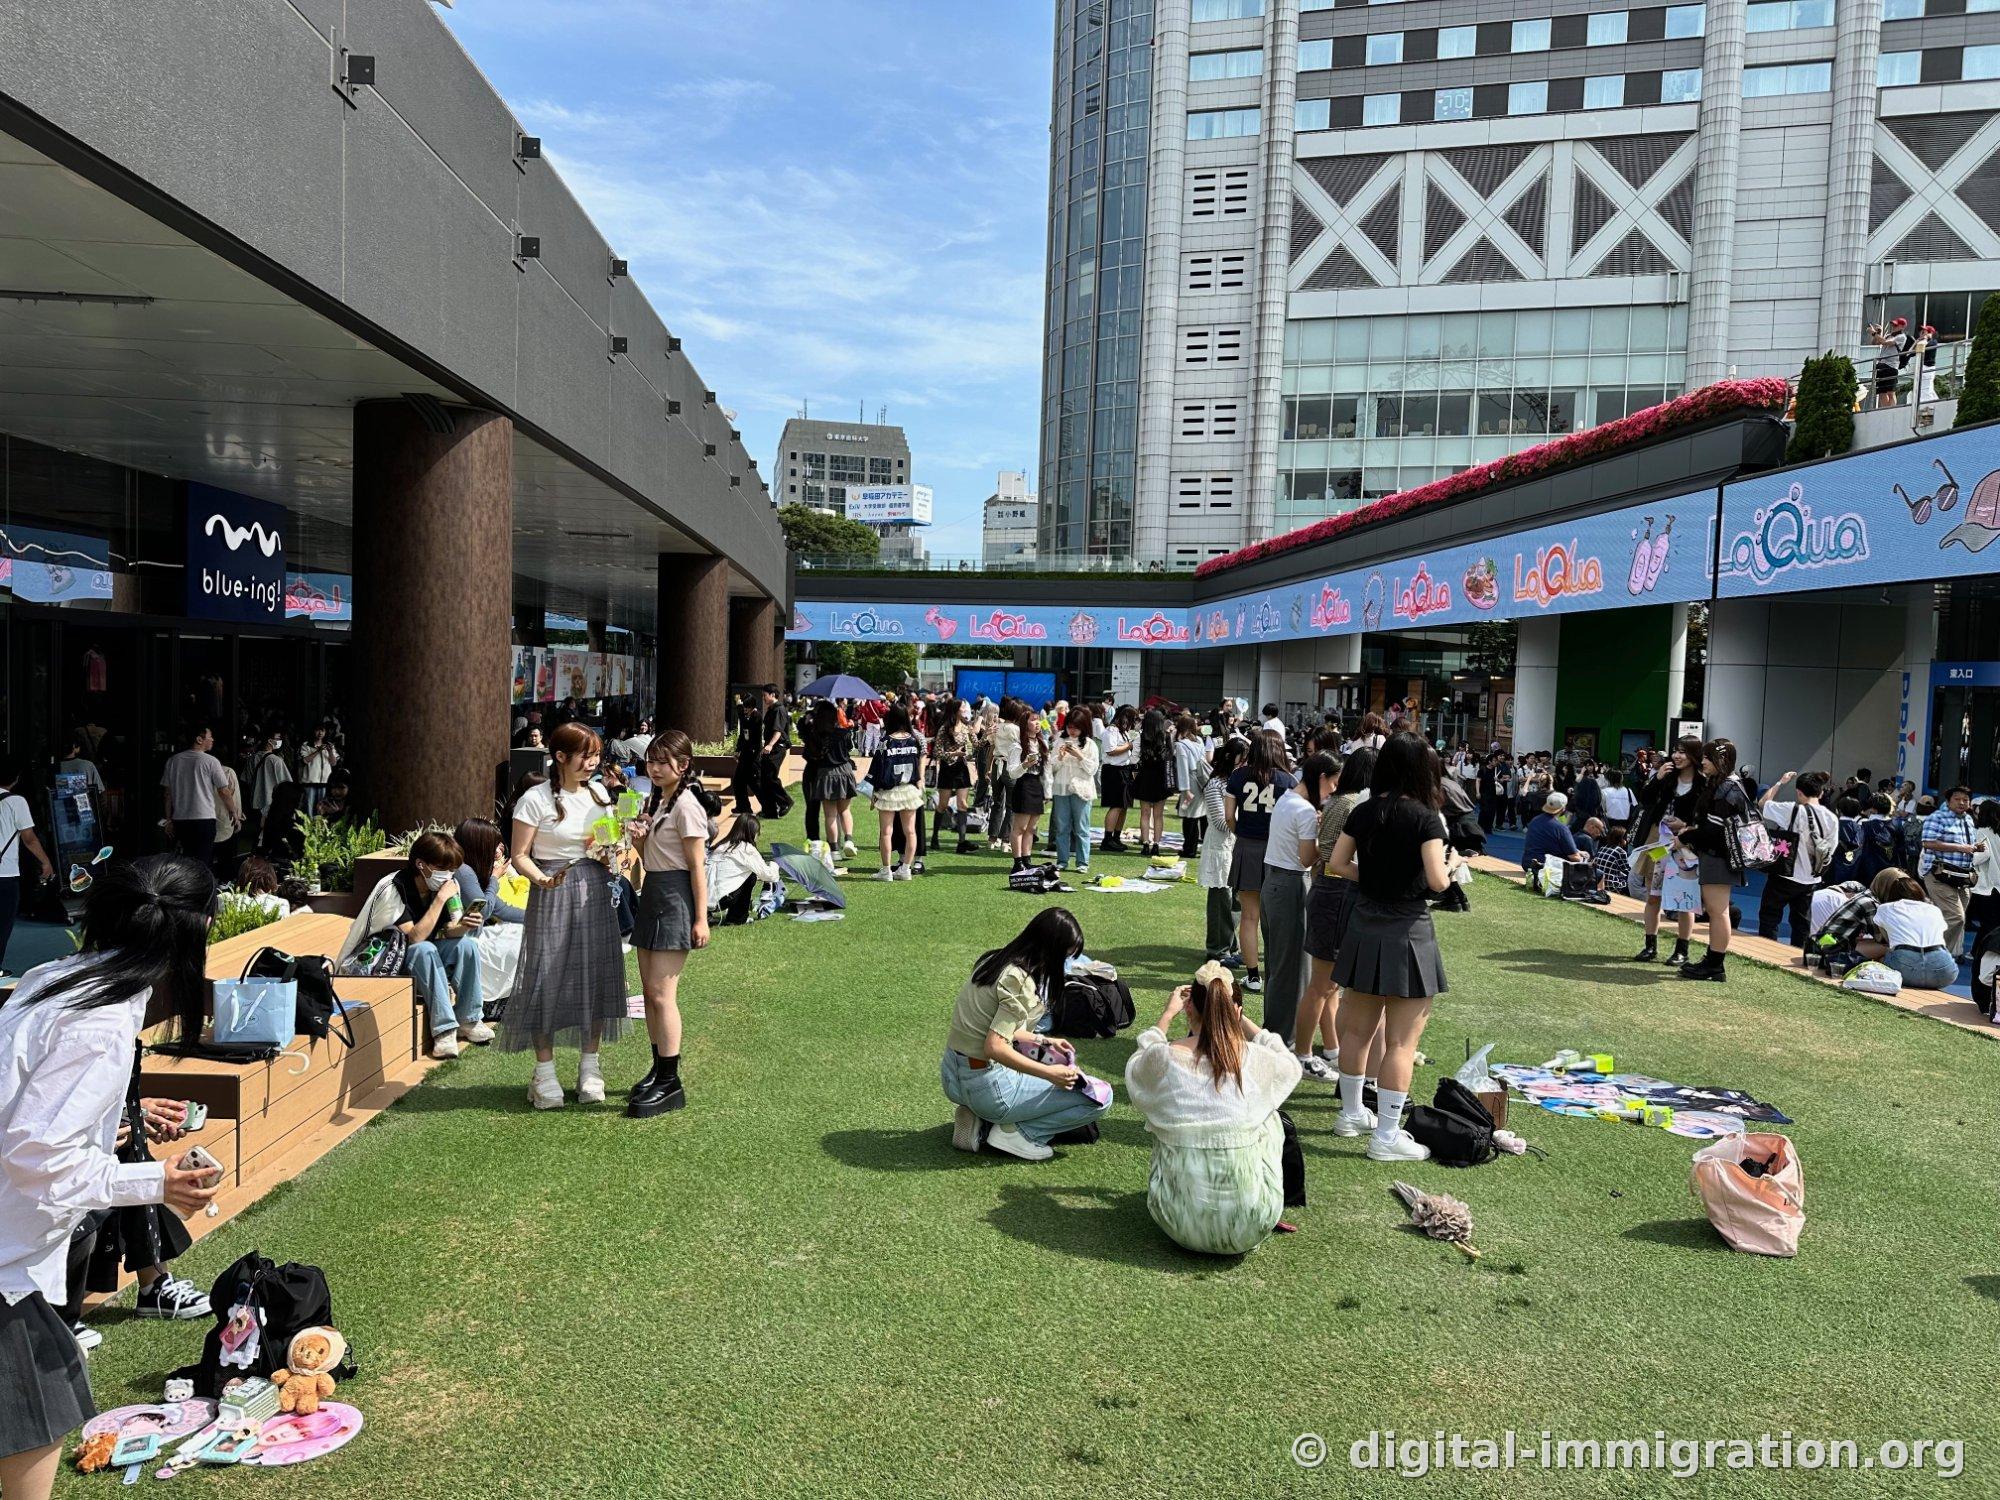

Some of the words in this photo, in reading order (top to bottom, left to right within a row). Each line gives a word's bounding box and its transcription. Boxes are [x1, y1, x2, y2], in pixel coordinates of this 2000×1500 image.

[1705, 482, 1869, 585] LaQua
[202, 568, 281, 612] blue-ing!
[1393, 561, 1451, 621] LaQua
[1513, 538, 1604, 608] LaQua
[830, 608, 904, 638] LaQua
[969, 609, 1048, 643] LaQua
[1310, 582, 1351, 631] LaQua
[893, 763, 914, 783] 7
[1242, 781, 1276, 814] 24
